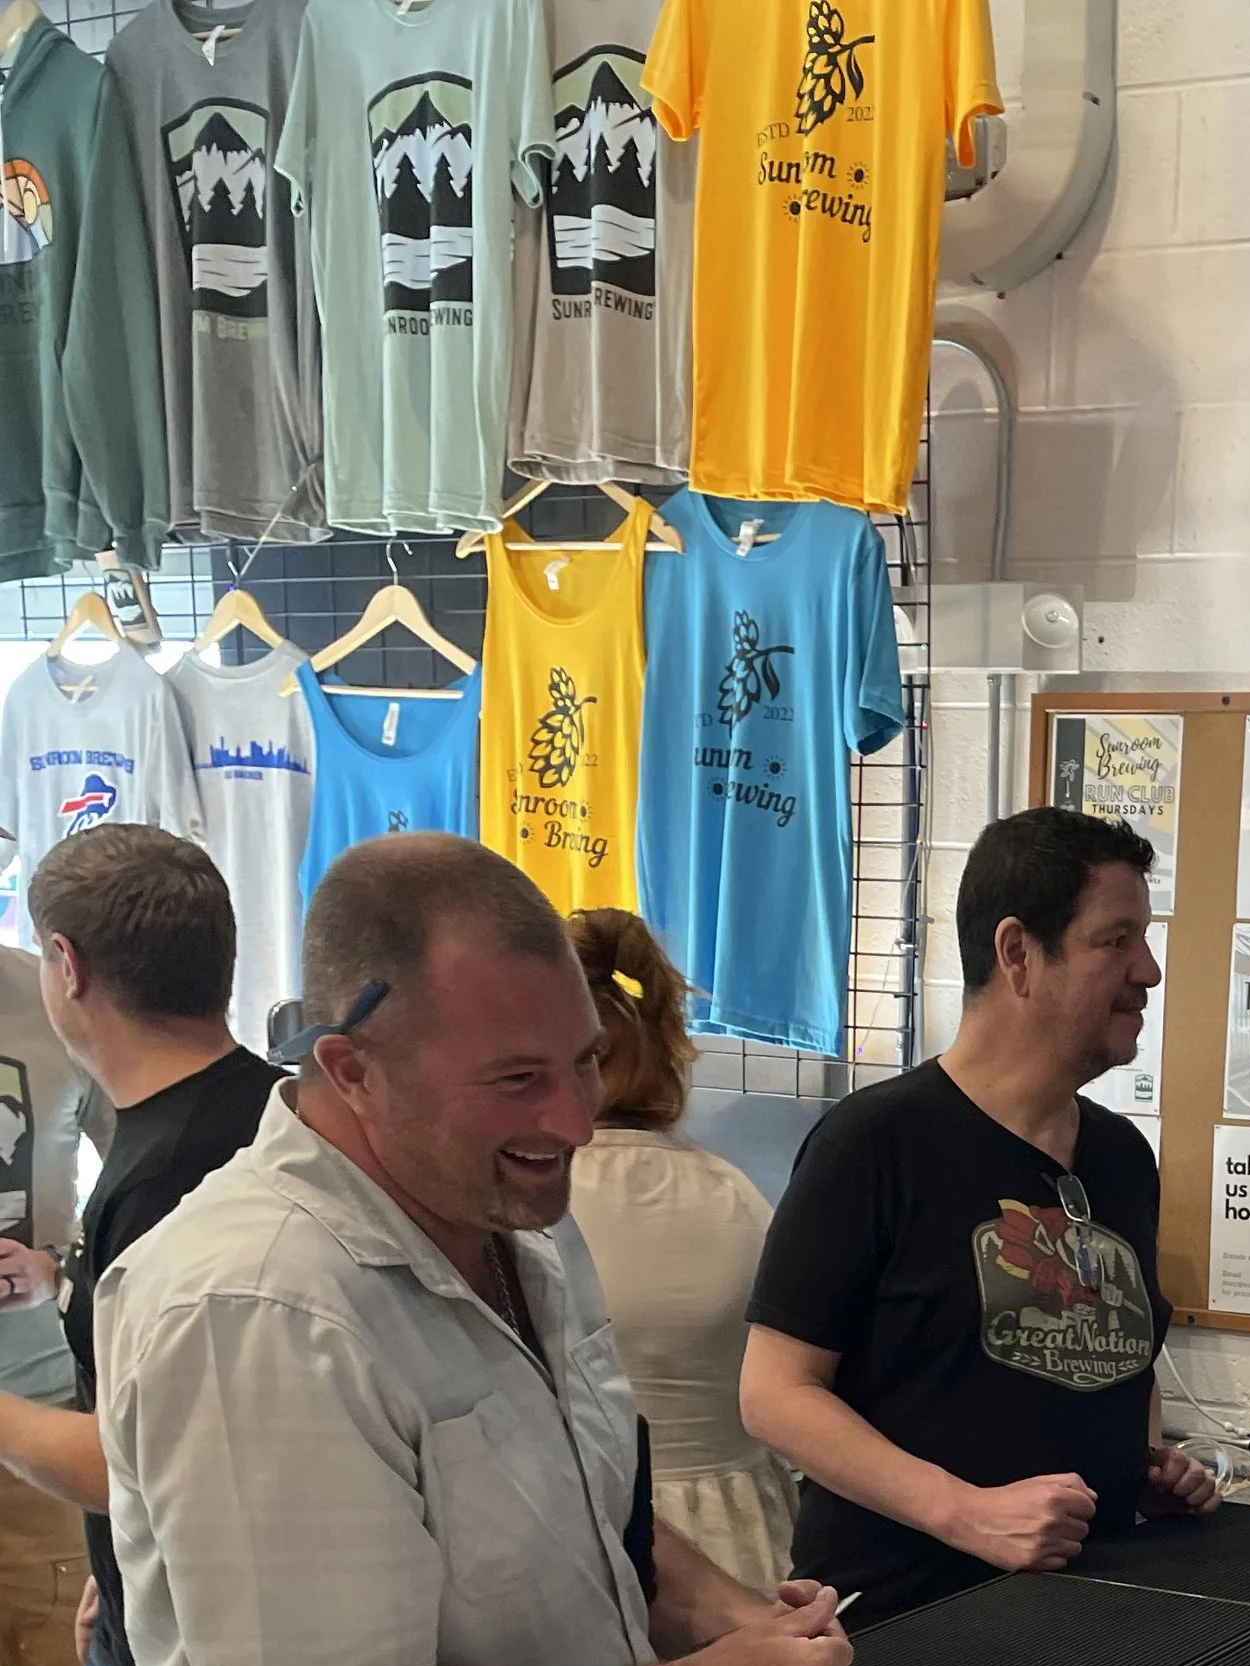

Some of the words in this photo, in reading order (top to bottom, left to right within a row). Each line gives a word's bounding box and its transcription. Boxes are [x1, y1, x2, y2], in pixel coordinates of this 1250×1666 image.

[1096, 732, 1162, 759] Sunroom
[1097, 752, 1162, 782] Brewing
[1084, 784, 1124, 803] RUN
[1127, 785, 1176, 804] CLUB
[1091, 803, 1164, 816] THURSDAYS
[1225, 1183, 1248, 1198] us
[987, 1310, 1079, 1350] Great
[1077, 1317, 1150, 1357] Notion
[1043, 1349, 1117, 1383] Brewing
